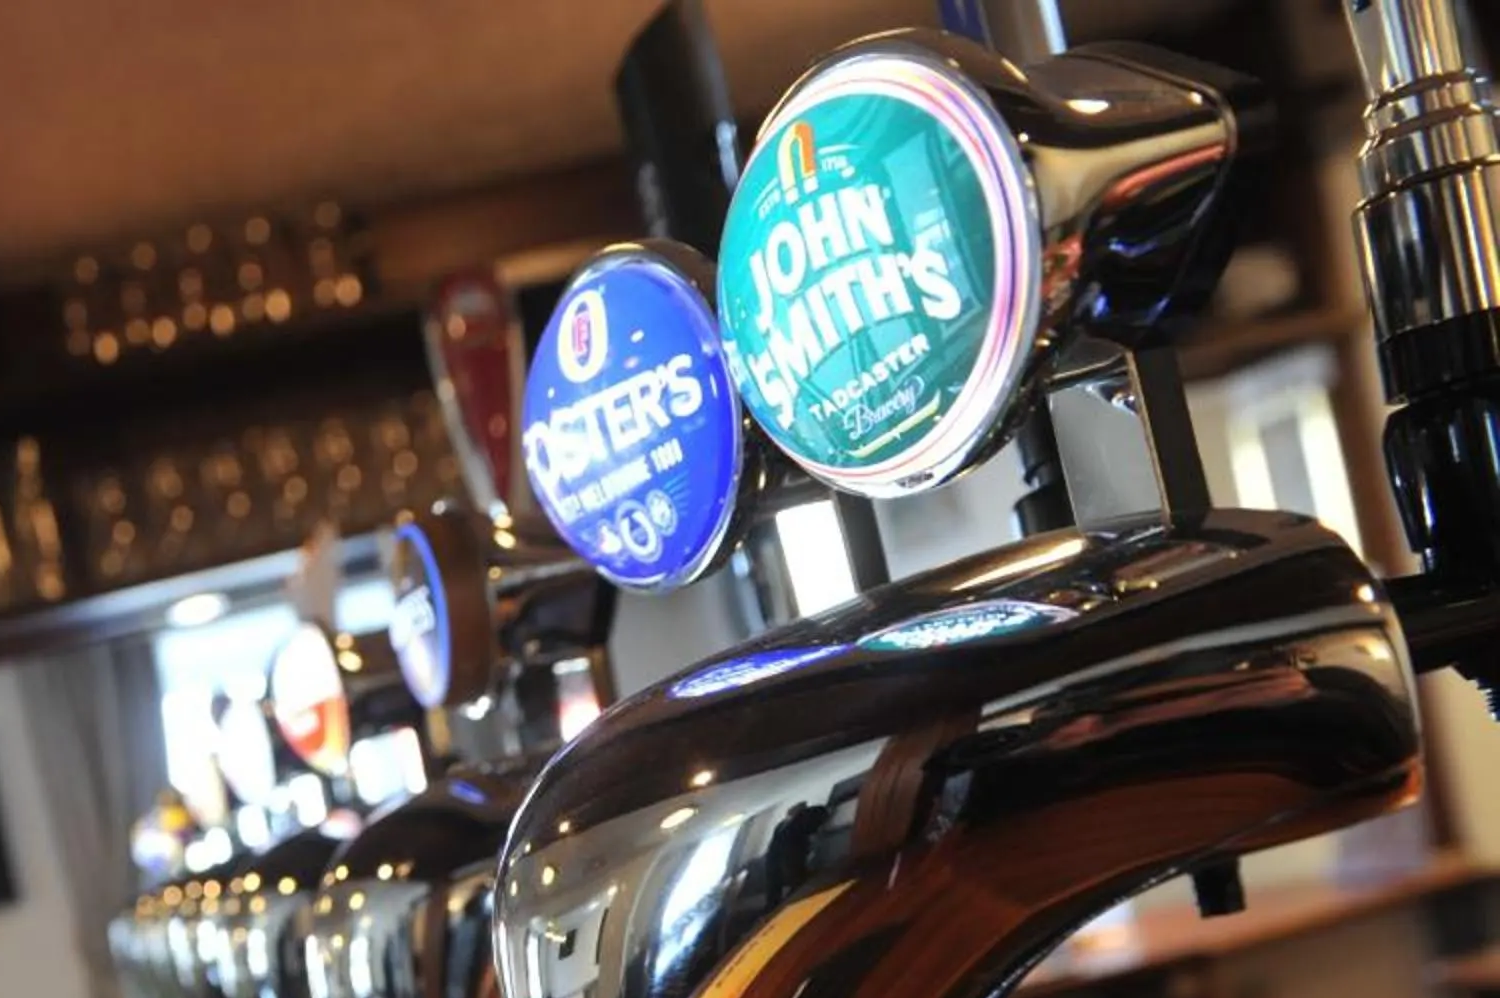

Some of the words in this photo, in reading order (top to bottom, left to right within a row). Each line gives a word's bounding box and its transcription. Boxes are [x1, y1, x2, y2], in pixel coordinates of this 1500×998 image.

[748, 183, 896, 330] JOHN
[747, 247, 962, 430] SMITH'S
[809, 333, 931, 422] TADCASTER
[522, 353, 702, 490] OSTER'S
